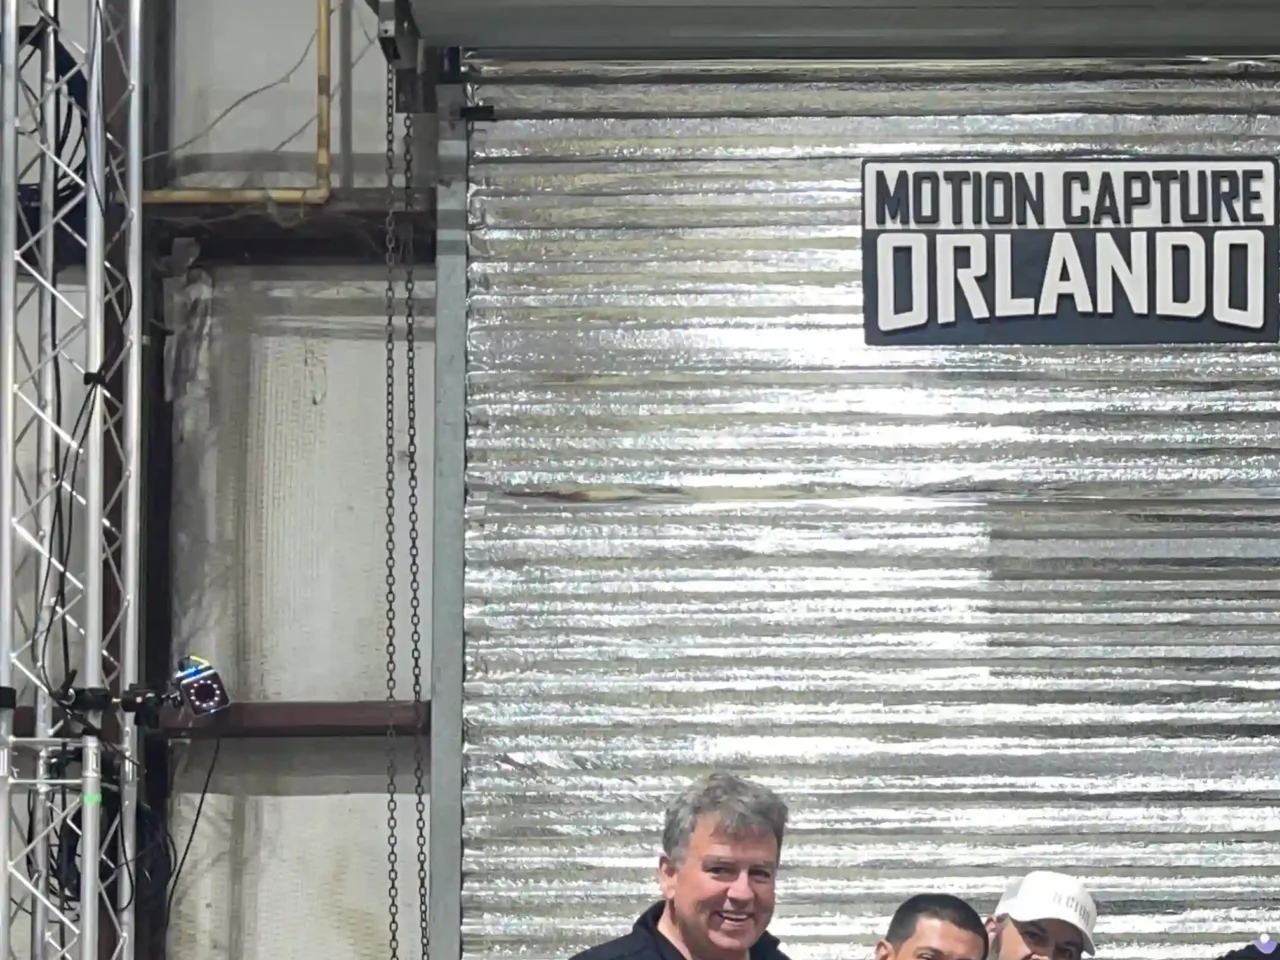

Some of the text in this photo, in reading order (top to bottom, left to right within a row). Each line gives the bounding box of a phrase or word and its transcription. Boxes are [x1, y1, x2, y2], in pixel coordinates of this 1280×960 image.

[875, 169, 1265, 226] MOTION CAPTURE
[876, 229, 1266, 332] ORLANDO
